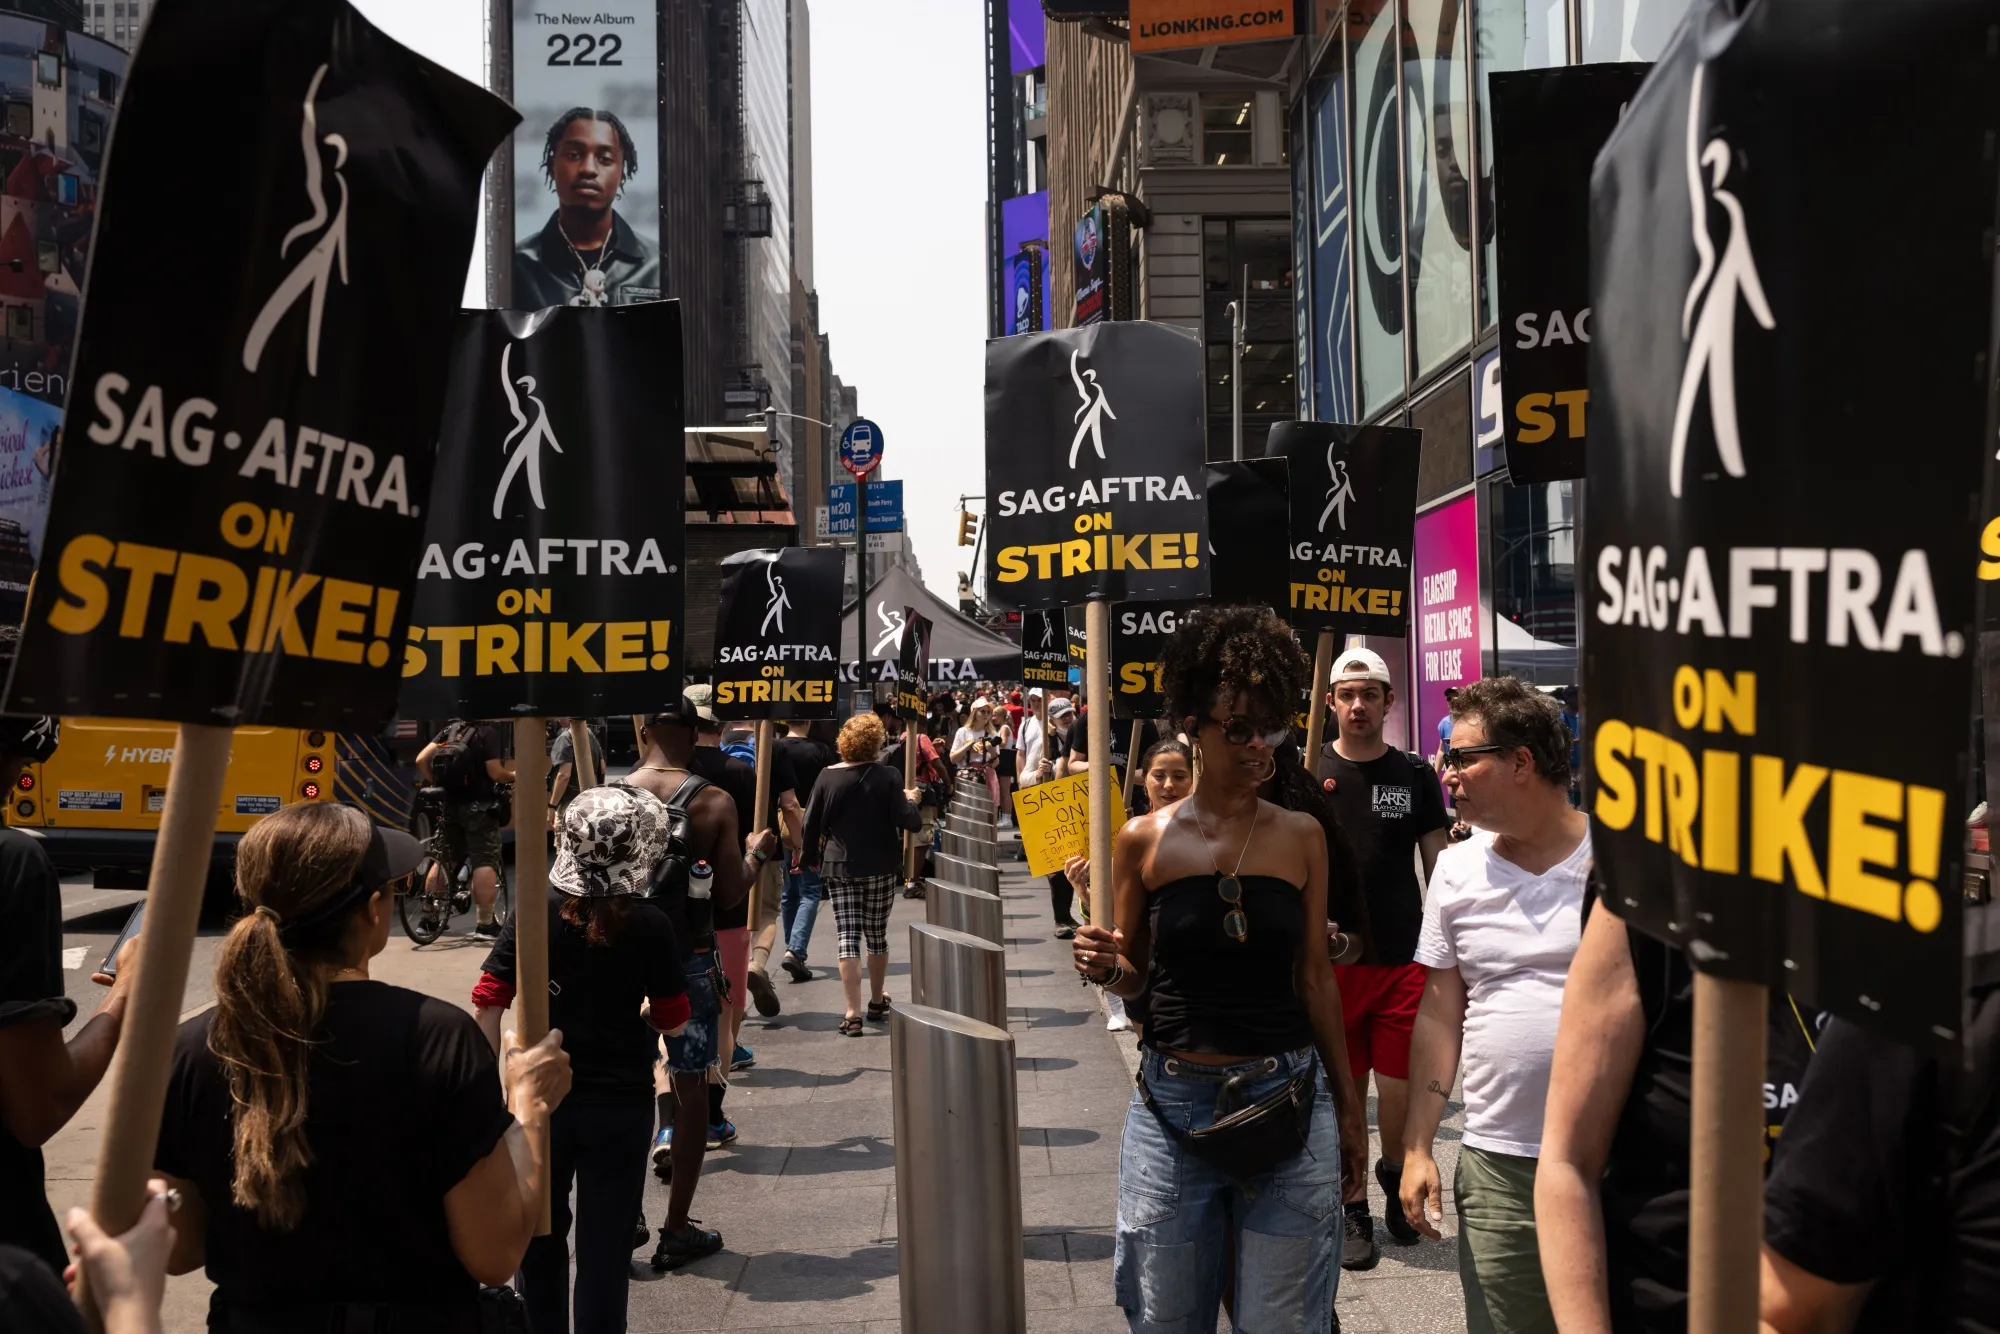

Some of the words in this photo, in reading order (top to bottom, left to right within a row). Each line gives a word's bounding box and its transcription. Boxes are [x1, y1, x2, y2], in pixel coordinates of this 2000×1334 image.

[535, 13, 559, 25] The
[562, 13, 591, 25] New
[593, 13, 635, 25] Album
[1140, 9, 1284, 38] LIONKING.COM
[548, 34, 623, 67] 222
[831, 486, 844, 499] M7
[831, 503, 851, 516] M20
[221, 502, 294, 556] ON
[831, 518, 856, 531] M104
[1074, 512, 1112, 534] ON
[996, 533, 1199, 583] STRIKE!
[1317, 568, 1346, 583] ON
[1423, 569, 1457, 606] FLAGSHIP
[48, 534, 399, 668] STRIKE!
[497, 588, 551, 616] ON
[1290, 582, 1402, 617] TRIKE!
[1424, 612, 1448, 643] RETAIL
[1448, 606, 1473, 641] SPACE
[762, 666, 785, 678] ON
[1024, 667, 1067, 683] STRIKE!
[1425, 651, 1439, 682] FOR
[1440, 648, 1462, 681] LEASE
[717, 680, 833, 704] STRIKE!
[1673, 664, 1756, 736] ON
[1378, 792, 1407, 806] ARTS
[1056, 803, 1085, 822] ON
[1381, 811, 1404, 819] STAFF
[1594, 718, 1945, 934] STRIKE!
